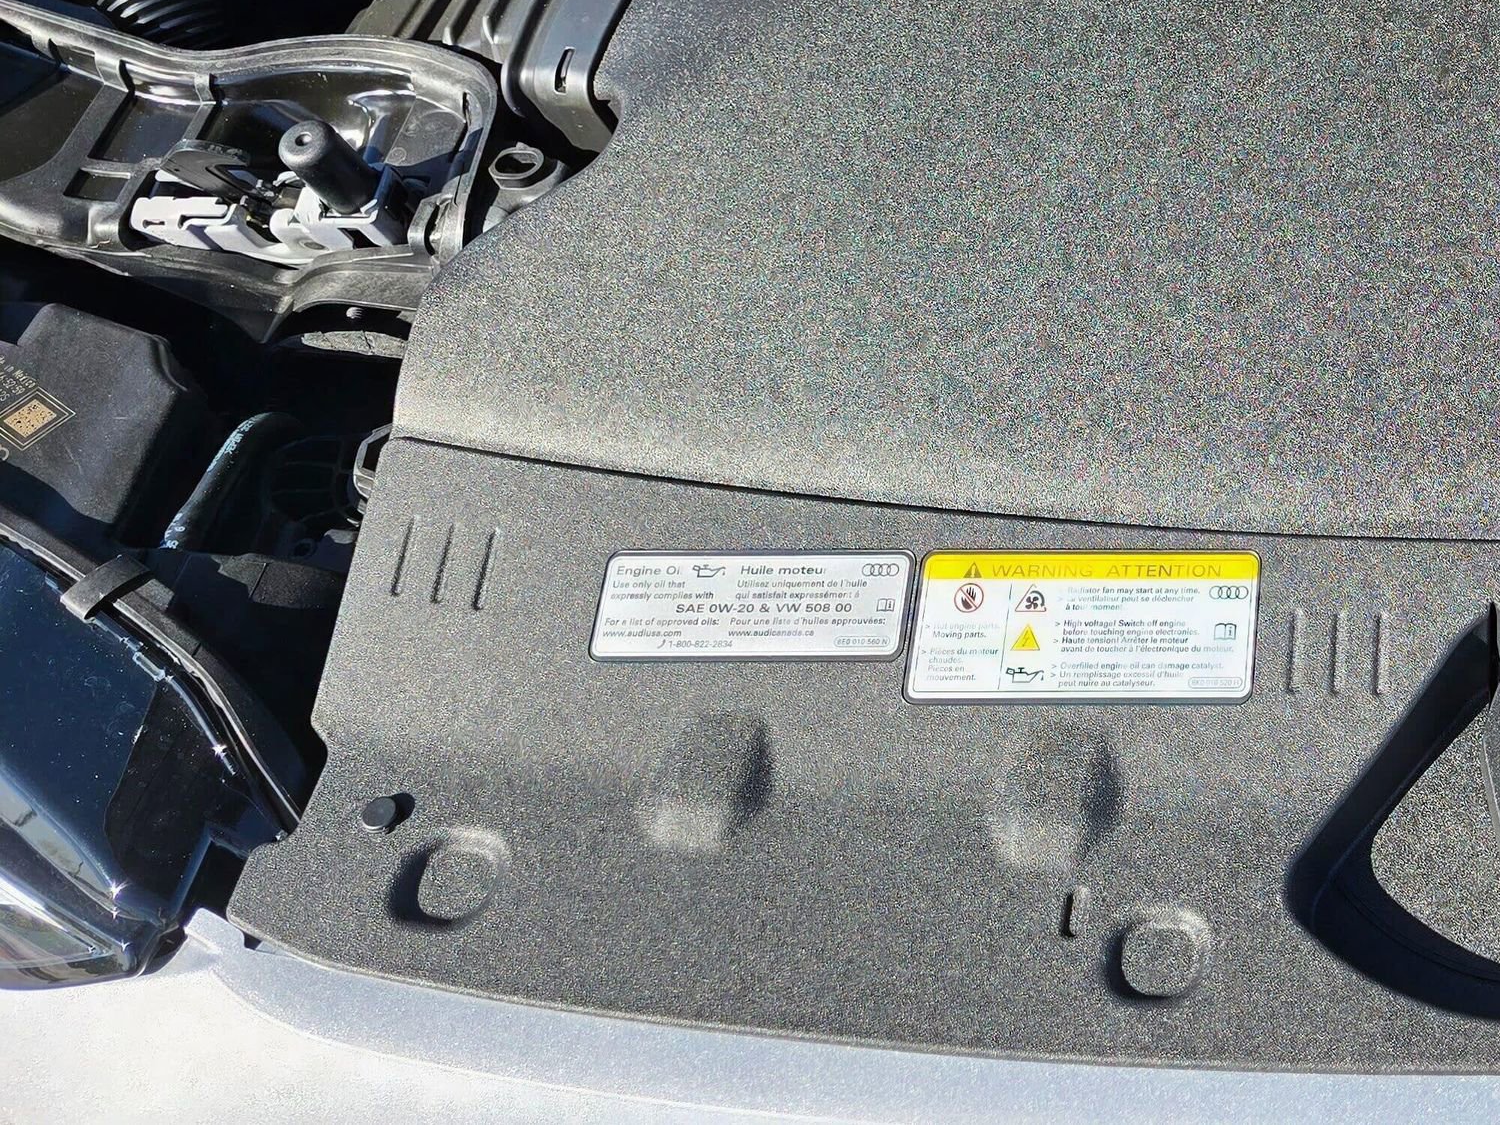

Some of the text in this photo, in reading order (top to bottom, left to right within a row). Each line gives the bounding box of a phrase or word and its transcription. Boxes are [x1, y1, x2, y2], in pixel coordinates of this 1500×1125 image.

[616, 565, 682, 577] Engine Oi
[740, 565, 774, 576] Huile
[992, 564, 1222, 578] WARNING ATTENTION
[612, 580, 686, 591] Use only oil that
[737, 579, 769, 589] Utilisez
[771, 579, 825, 590] uniquement
[827, 580, 838, 588] de
[735, 591, 749, 601] qui
[752, 591, 787, 600] satisfait
[1102, 586, 1115, 594] fan
[1116, 588, 1133, 596] may
[1164, 588, 1179, 596] any
[610, 591, 714, 602] expressly complies with
[1121, 596, 1139, 604] peut
[675, 603, 852, 614] SAE 0W-20 & VW 508 00
[604, 617, 619, 626] For
[629, 617, 642, 626] list
[645, 617, 655, 626] of
[656, 617, 698, 628] approved
[701, 617, 720, 626] oils:
[729, 617, 751, 626] Pour
[753, 618, 770, 626] une
[831, 617, 886, 627] approuvées:
[1063, 619, 1082, 629] High
[1118, 619, 1145, 627] Switch
[1147, 619, 1158, 627] off
[1159, 619, 1186, 629] engine
[602, 628, 682, 638] www.audiusa.com
[728, 628, 815, 638] www.audicanada.ca
[932, 630, 987, 640] Moving parts.
[1063, 627, 1088, 636] before
[1090, 628, 1125, 637] touching
[1126, 628, 1153, 637] engine
[669, 639, 733, 648] 1-800-822-2834
[1061, 636, 1085, 644] Haute
[1150, 636, 1158, 644] le
[956, 647, 968, 656] du
[1060, 645, 1083, 653] avant
[1085, 645, 1095, 653] de
[1096, 645, 1127, 653] toucher
[1190, 644, 1201, 653] du
[1129, 662, 1140, 670] oil
[1058, 680, 1076, 688] peut
[1078, 679, 1099, 687] nuire
[1112, 679, 1156, 688] catalyseur.
